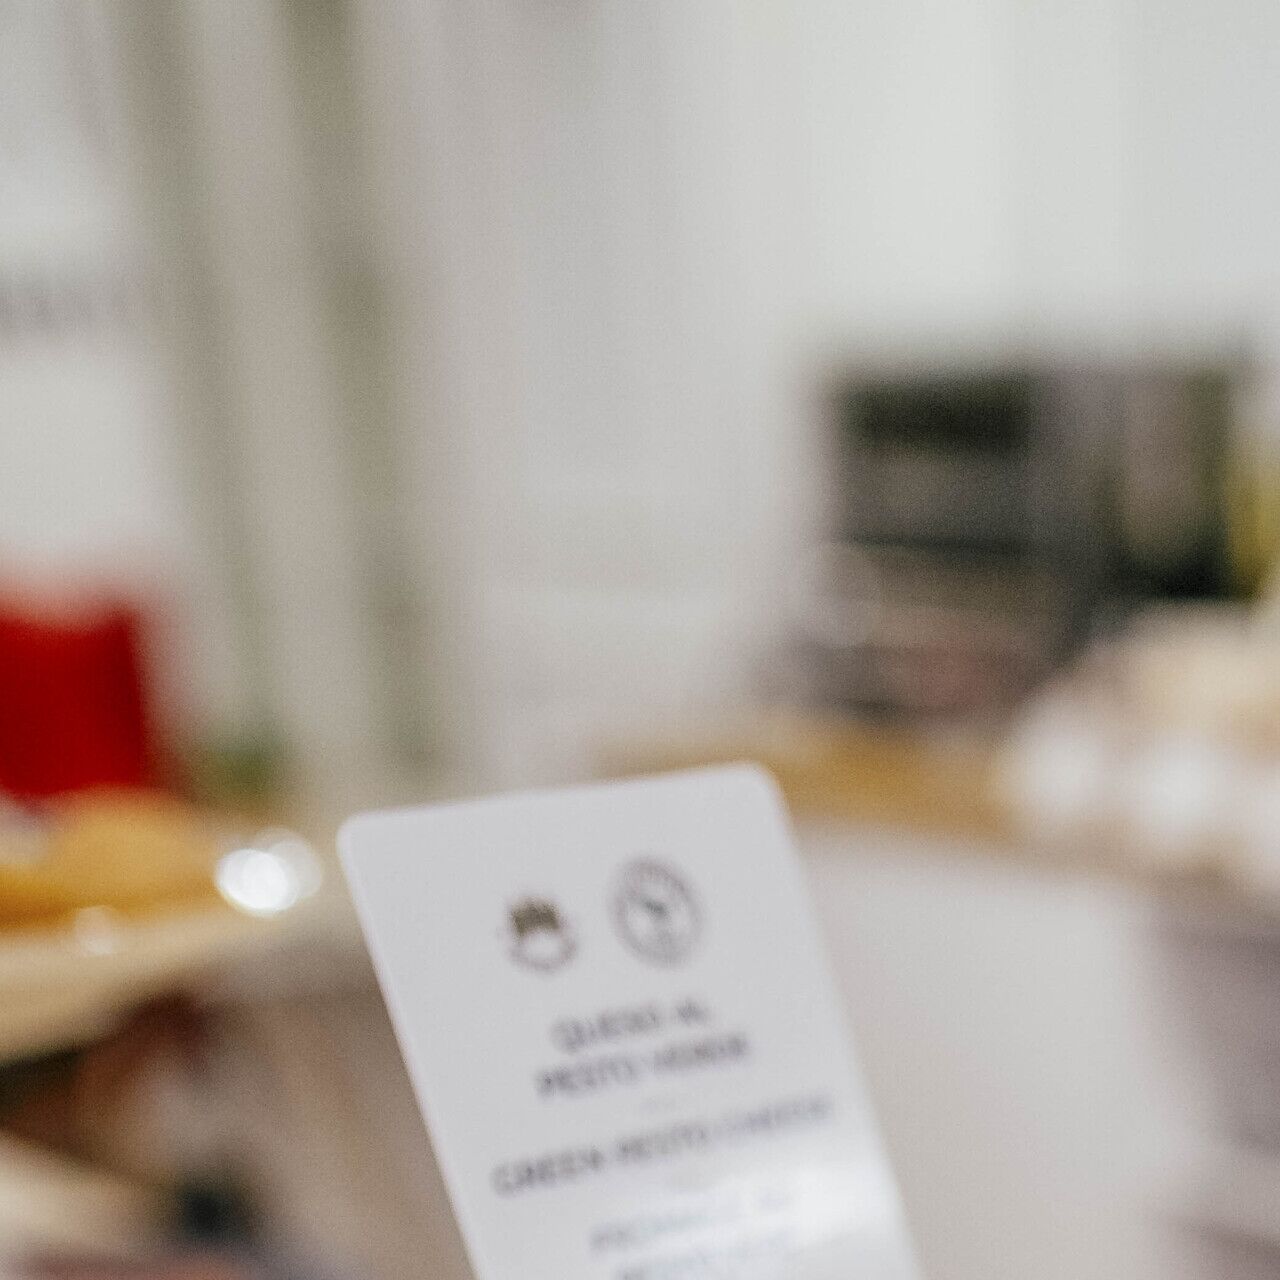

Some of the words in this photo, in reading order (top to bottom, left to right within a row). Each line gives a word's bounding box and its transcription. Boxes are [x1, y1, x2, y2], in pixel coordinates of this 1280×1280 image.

[536, 1055, 638, 1097] PESTO
[492, 1146, 604, 1196] GREEN
[615, 1120, 711, 1165] PESTO
